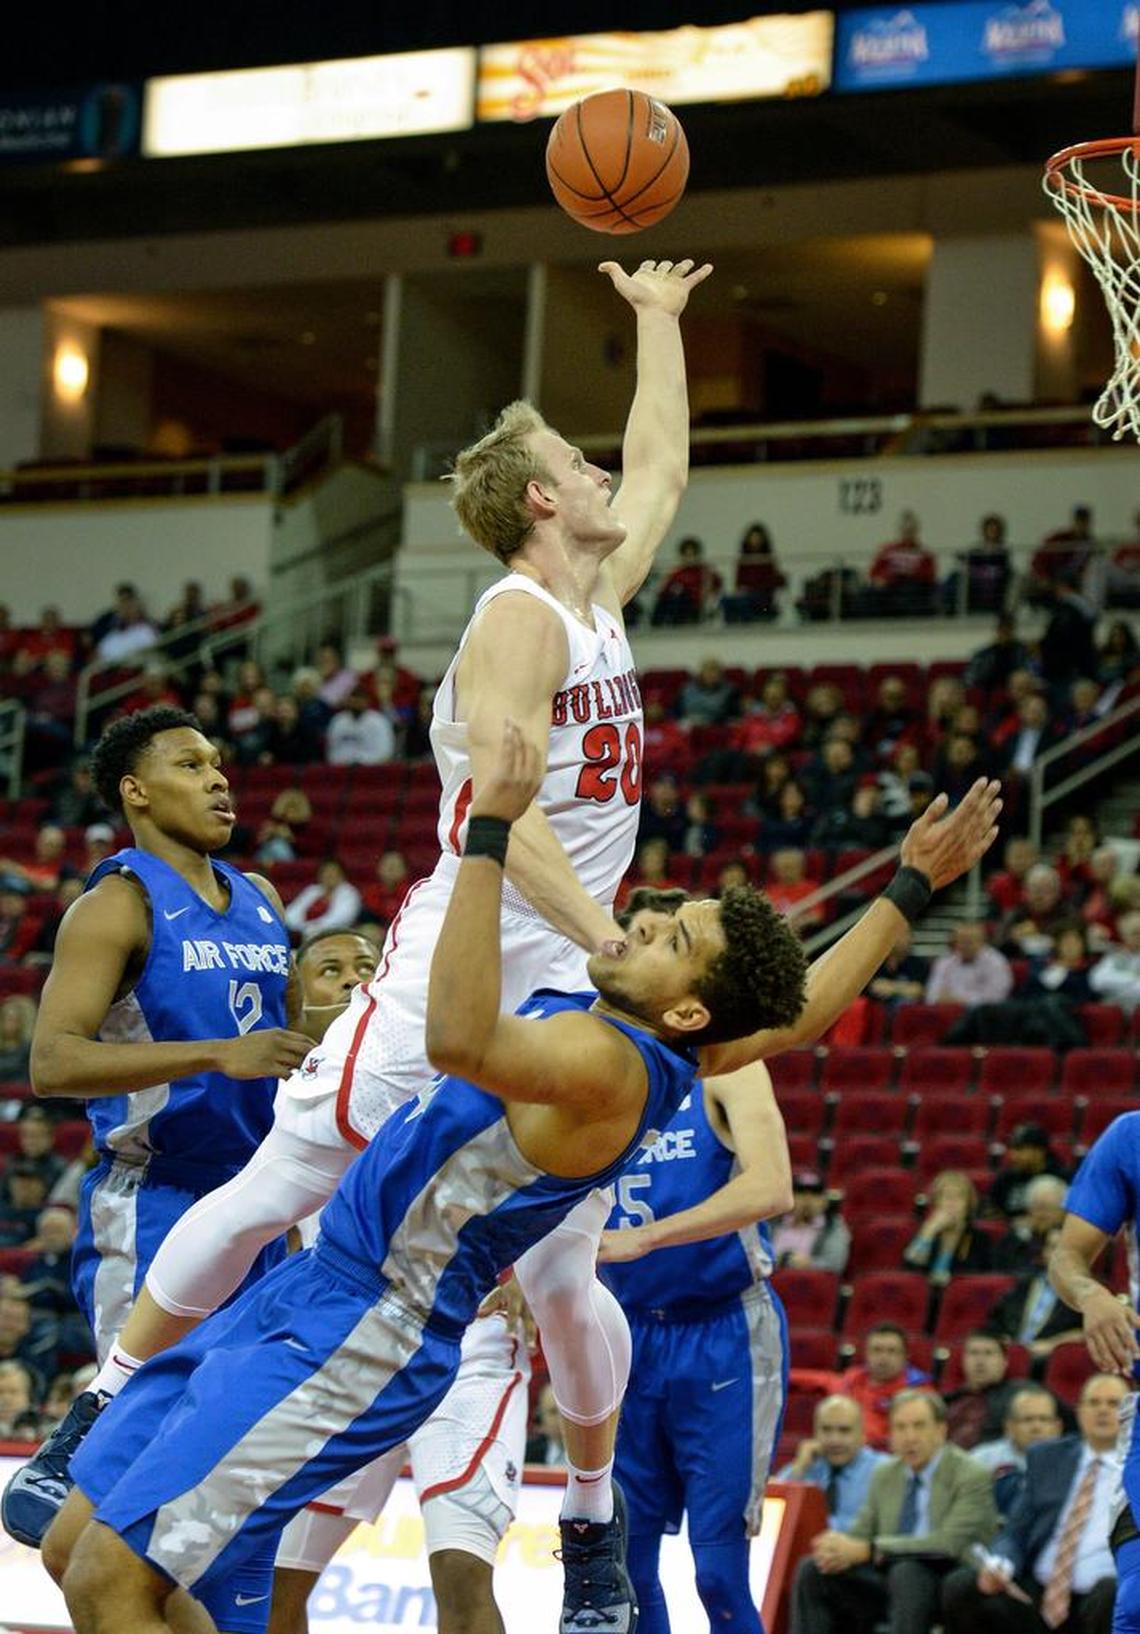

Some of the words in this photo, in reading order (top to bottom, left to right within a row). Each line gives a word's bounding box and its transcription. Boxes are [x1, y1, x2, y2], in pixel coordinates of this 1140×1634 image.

[574, 722, 642, 807] 20
[182, 939, 225, 972] AIR
[222, 941, 289, 976] FORCE
[637, 1128, 697, 1165] RCE
[611, 1173, 656, 1230] 5
[306, 1565, 436, 1626] Ban
